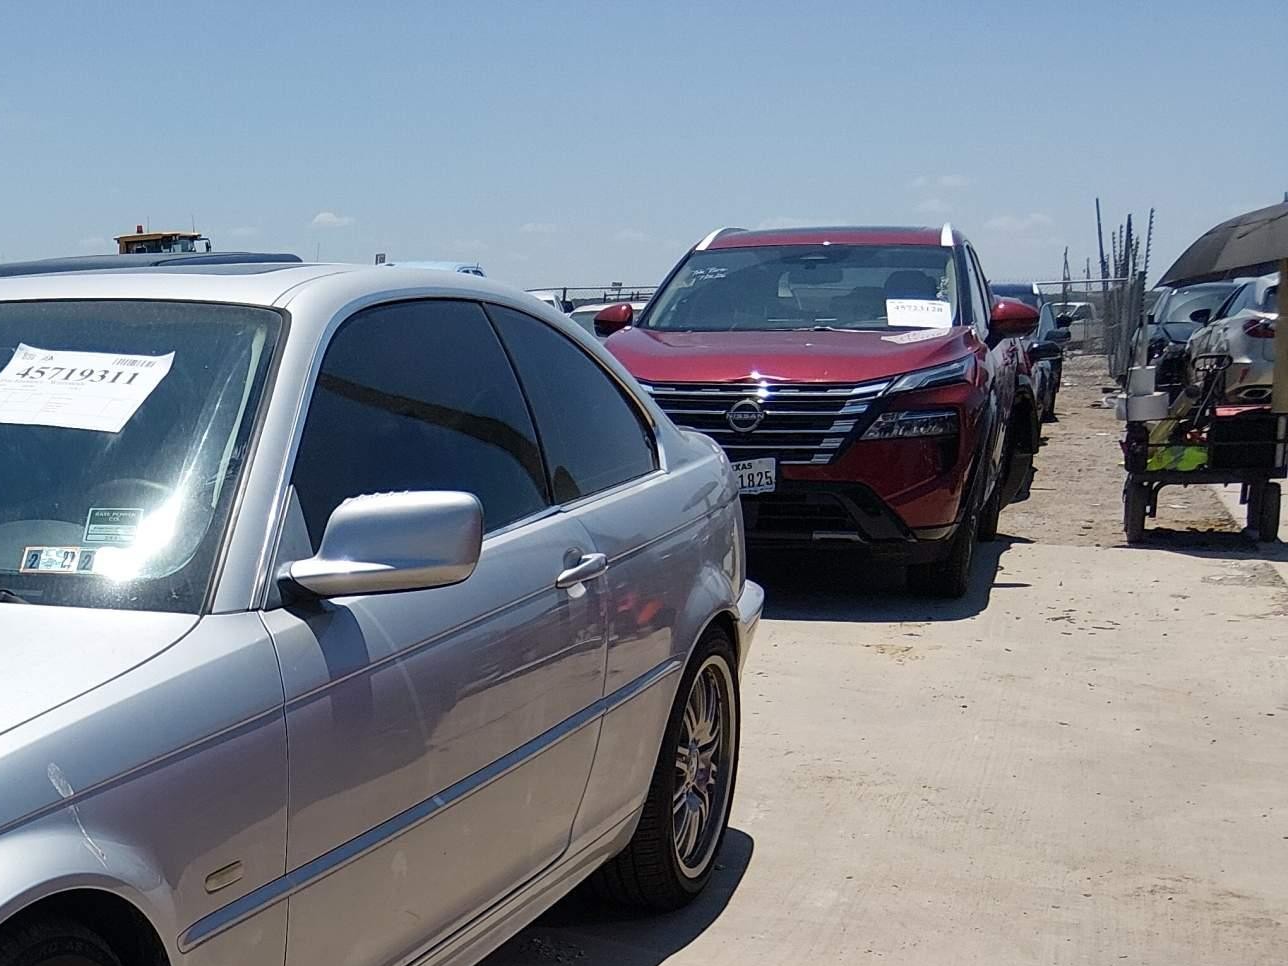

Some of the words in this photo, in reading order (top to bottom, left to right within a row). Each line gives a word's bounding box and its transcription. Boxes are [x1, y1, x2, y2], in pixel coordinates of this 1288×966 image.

[15, 365, 140, 385] 45719311
[726, 412, 765, 420] NISSAN
[738, 470, 773, 489] 1825
[28, 553, 39, 569] 2
